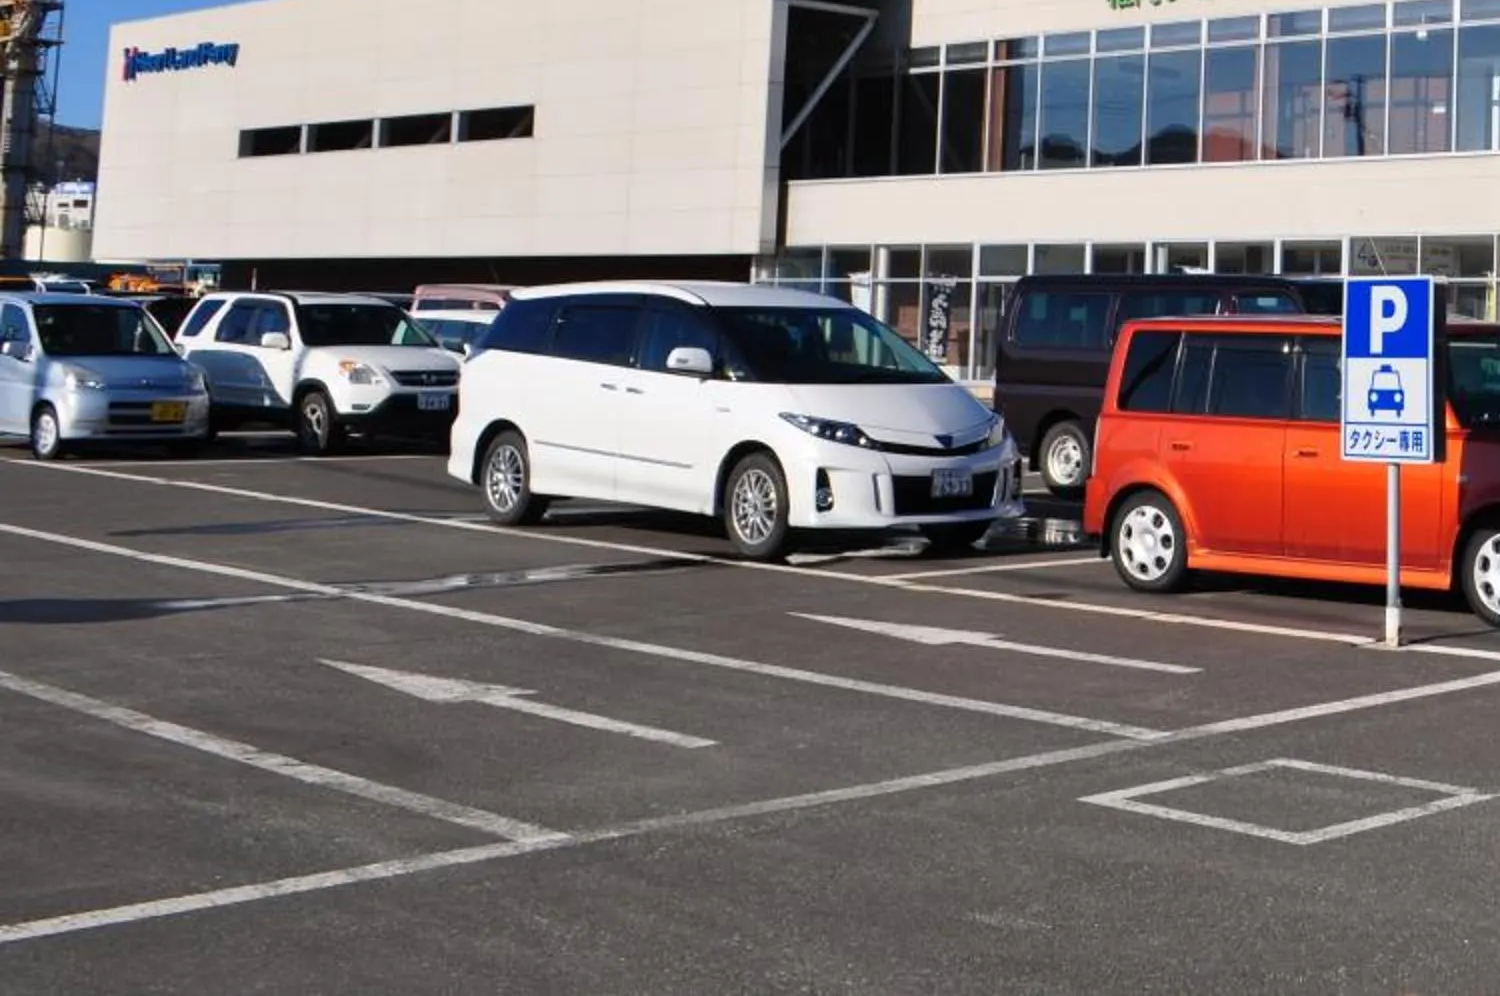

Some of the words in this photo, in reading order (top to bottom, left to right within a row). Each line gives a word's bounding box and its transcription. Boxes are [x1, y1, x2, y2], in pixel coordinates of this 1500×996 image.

[1369, 285, 1409, 355] P
[1349, 429, 1424, 453] タクシー専用
